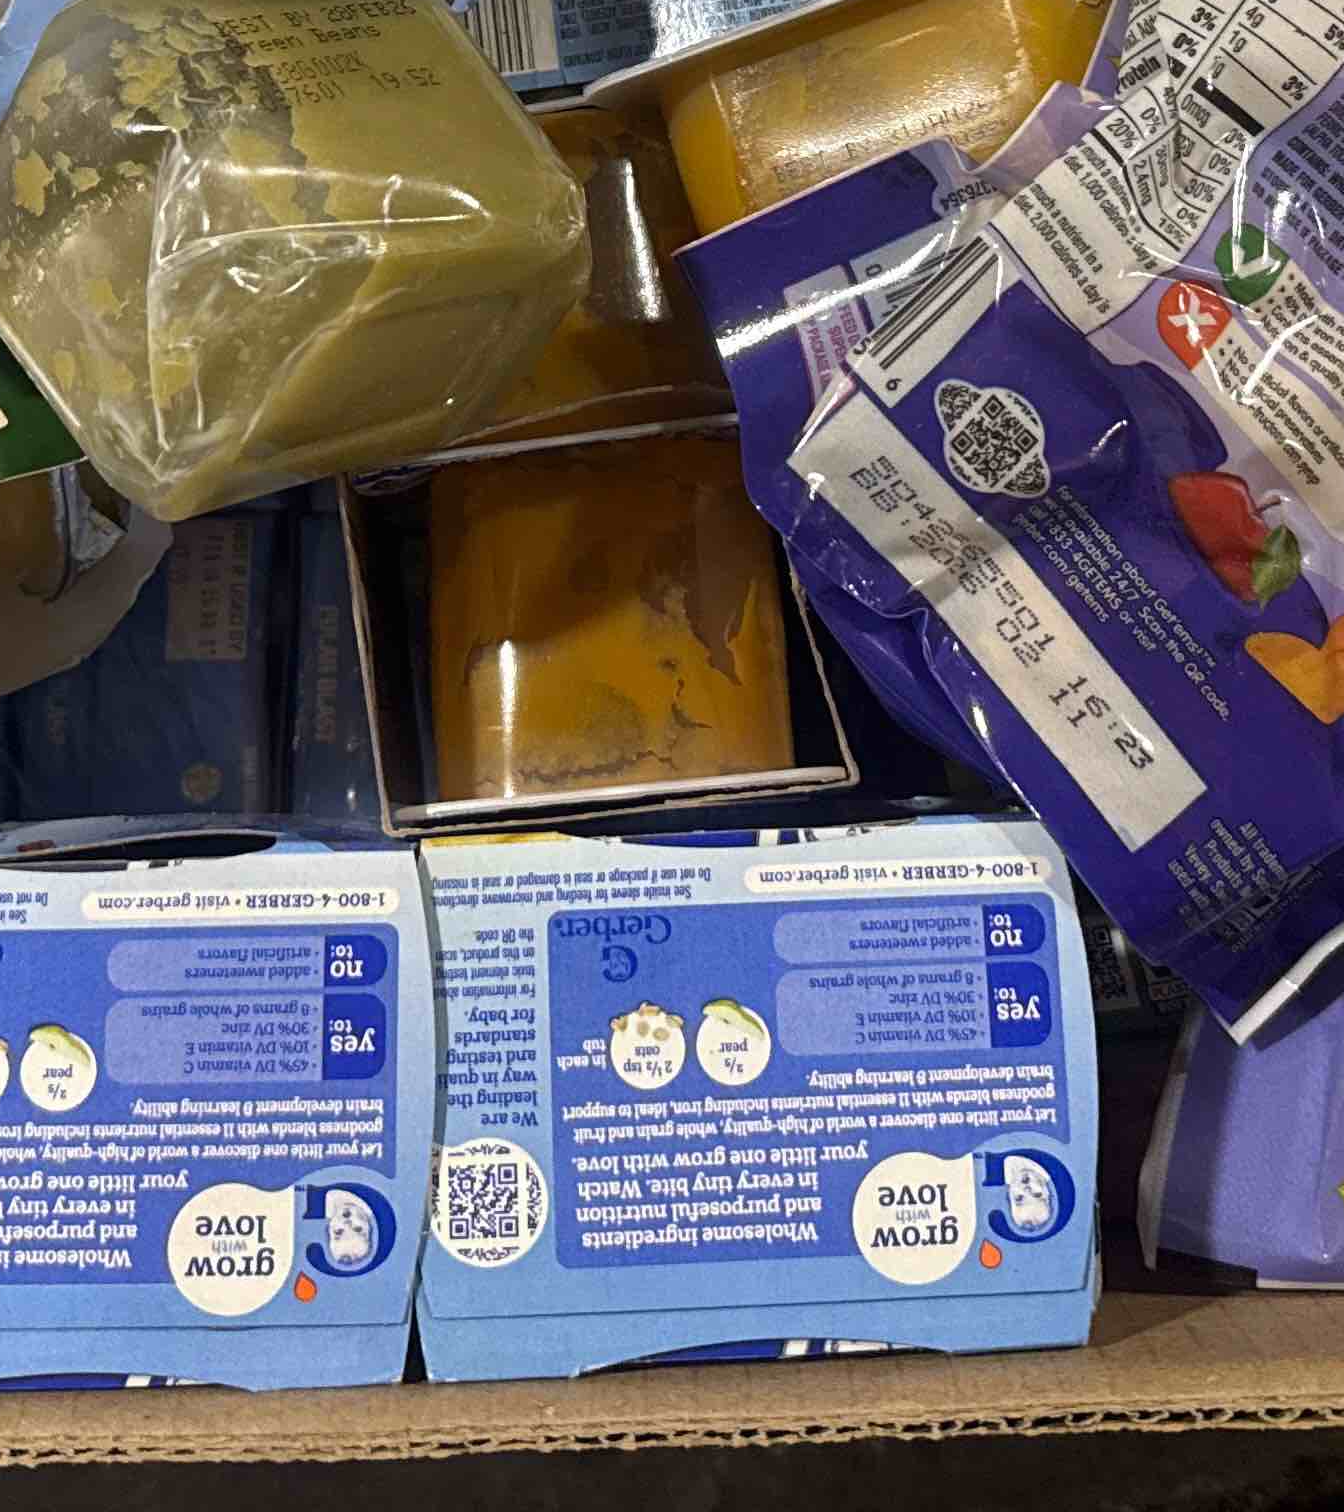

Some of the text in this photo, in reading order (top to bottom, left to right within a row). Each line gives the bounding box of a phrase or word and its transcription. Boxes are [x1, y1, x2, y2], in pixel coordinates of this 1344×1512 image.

[213, 13, 273, 38] BEST
[310, 24, 381, 44] Beans
[1048, 688, 1088, 729] 11
[1066, 675, 1155, 771] 16:23
[97, 891, 386, 914] 1-800-4-GERBER visit gerber.com
[328, 945, 354, 961] to:
[329, 959, 363, 980] no
[328, 1017, 352, 1034] to:
[329, 1024, 375, 1056] yes
[47, 1174, 85, 1190] one
[89, 1174, 135, 1194] little
[140, 1170, 189, 1190] your
[8, 1193, 49, 1219] tiny
[54, 1194, 109, 1216] every
[114, 1200, 136, 1218] in
[877, 1184, 946, 1212] love
[101, 1224, 138, 1242] and
[194, 1214, 267, 1242] love
[582, 1222, 818, 1250] Wholesome ingredients
[870, 1222, 959, 1250] grow
[212, 1240, 247, 1254] with
[14, 1248, 132, 1270] Wholesome
[185, 1249, 276, 1280] grow
